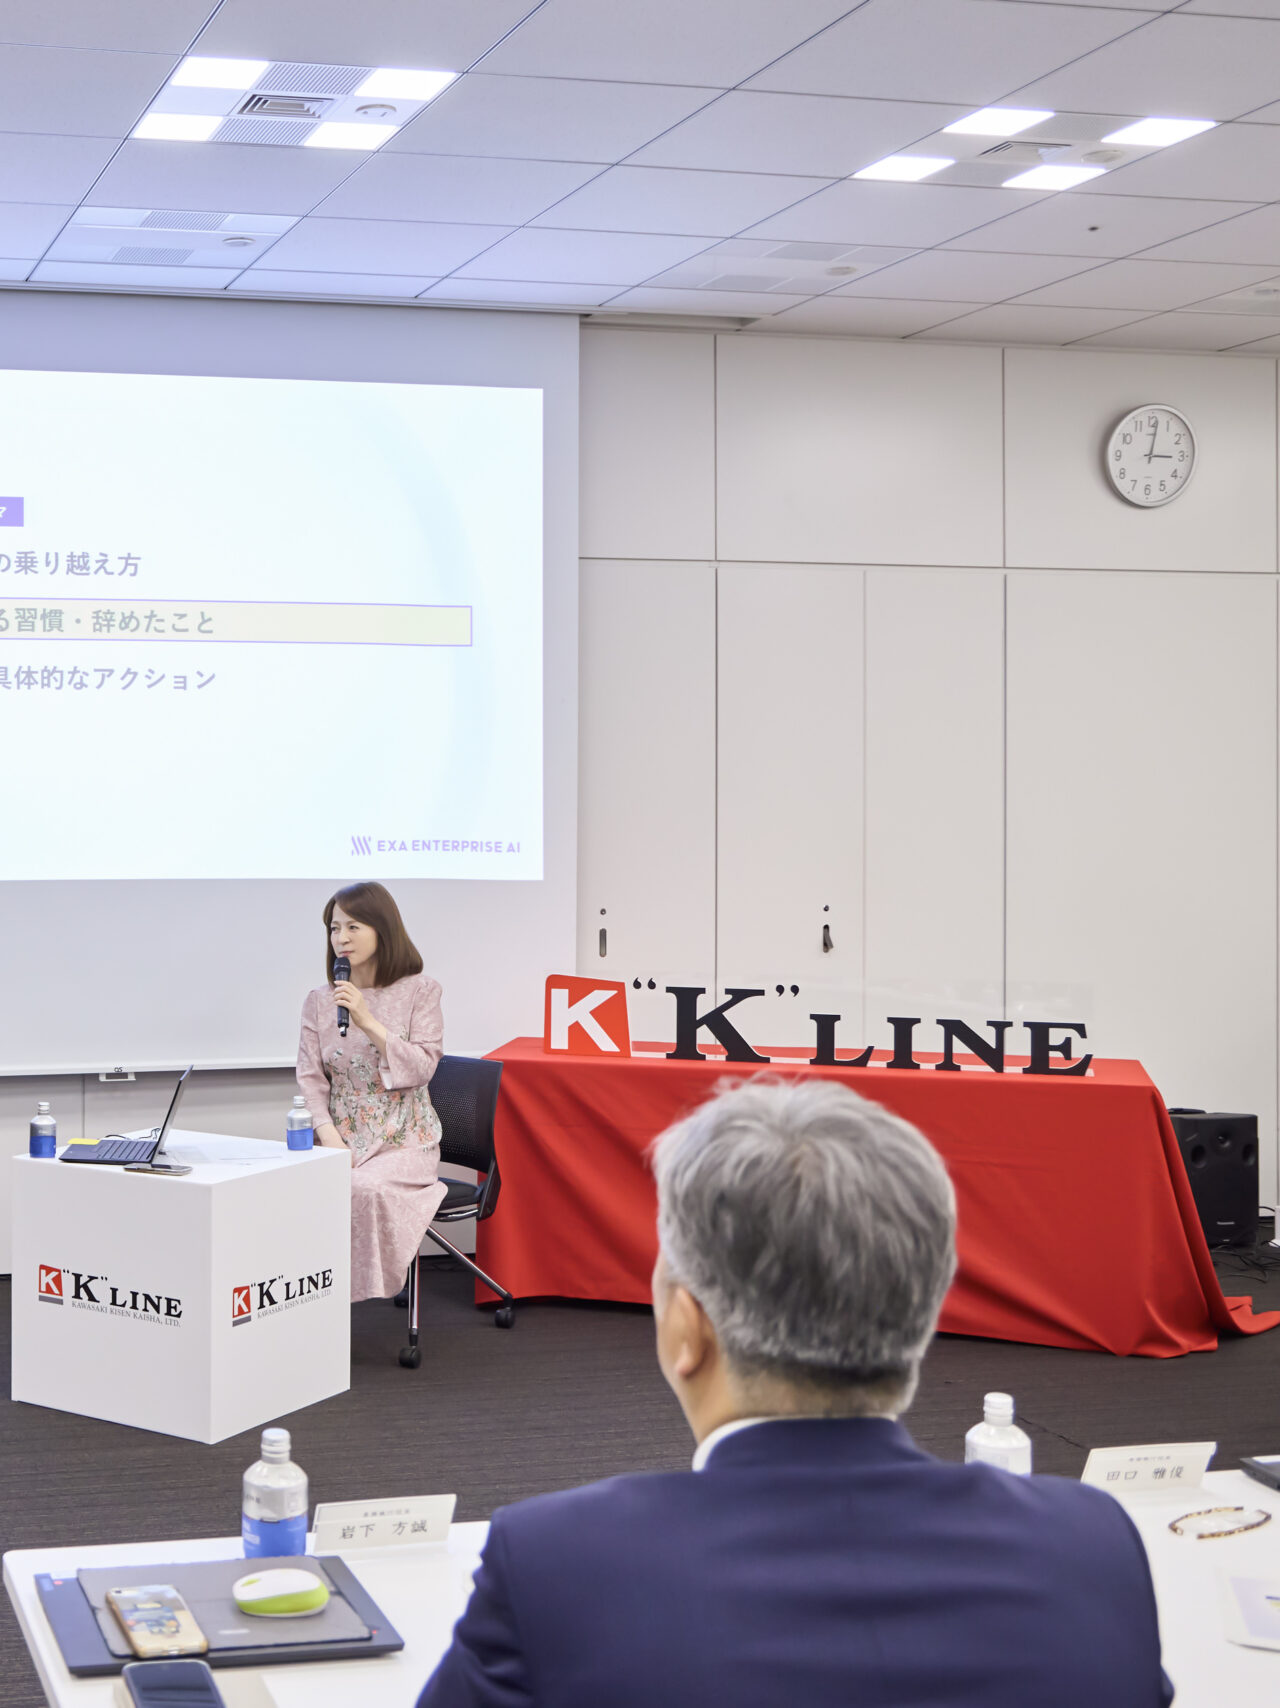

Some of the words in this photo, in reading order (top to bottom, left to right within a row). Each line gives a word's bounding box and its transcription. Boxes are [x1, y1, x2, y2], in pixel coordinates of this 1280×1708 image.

[1134, 420, 1143, 432] 11
[1166, 420, 1170, 432] 1
[1122, 432, 1132, 445] 10
[1174, 433, 1181, 445] 2
[1114, 449, 1122, 462] 9
[1178, 450, 1185, 462] 3
[1118, 467, 1126, 480] 8
[1170, 468, 1178, 480] 4
[1130, 479, 1138, 491] 7
[1144, 484, 1151, 496] 6
[1159, 480, 1166, 492] 5
[377, 840, 408, 852] EXA
[412, 840, 503, 853] ENTERPRISE
[506, 841, 520, 853] AI
[550, 988, 620, 1052] K
[809, 1013, 1093, 1076] LINE
[40, 1269, 60, 1295] K
[110, 1287, 182, 1318] LINE
[233, 1289, 248, 1316] K
[284, 1269, 333, 1301] LINE
[71, 1301, 108, 1314] KAWASAKI
[110, 1306, 131, 1318] KISEN
[133, 1311, 163, 1324] KAISHA,
[165, 1317, 180, 1327] LTD.
[257, 1305, 284, 1319] KAWASAKI
[285, 1300, 299, 1311] KISEN
[1106, 1470, 1138, 1481] 田口
[339, 1523, 376, 1540] 岩下
